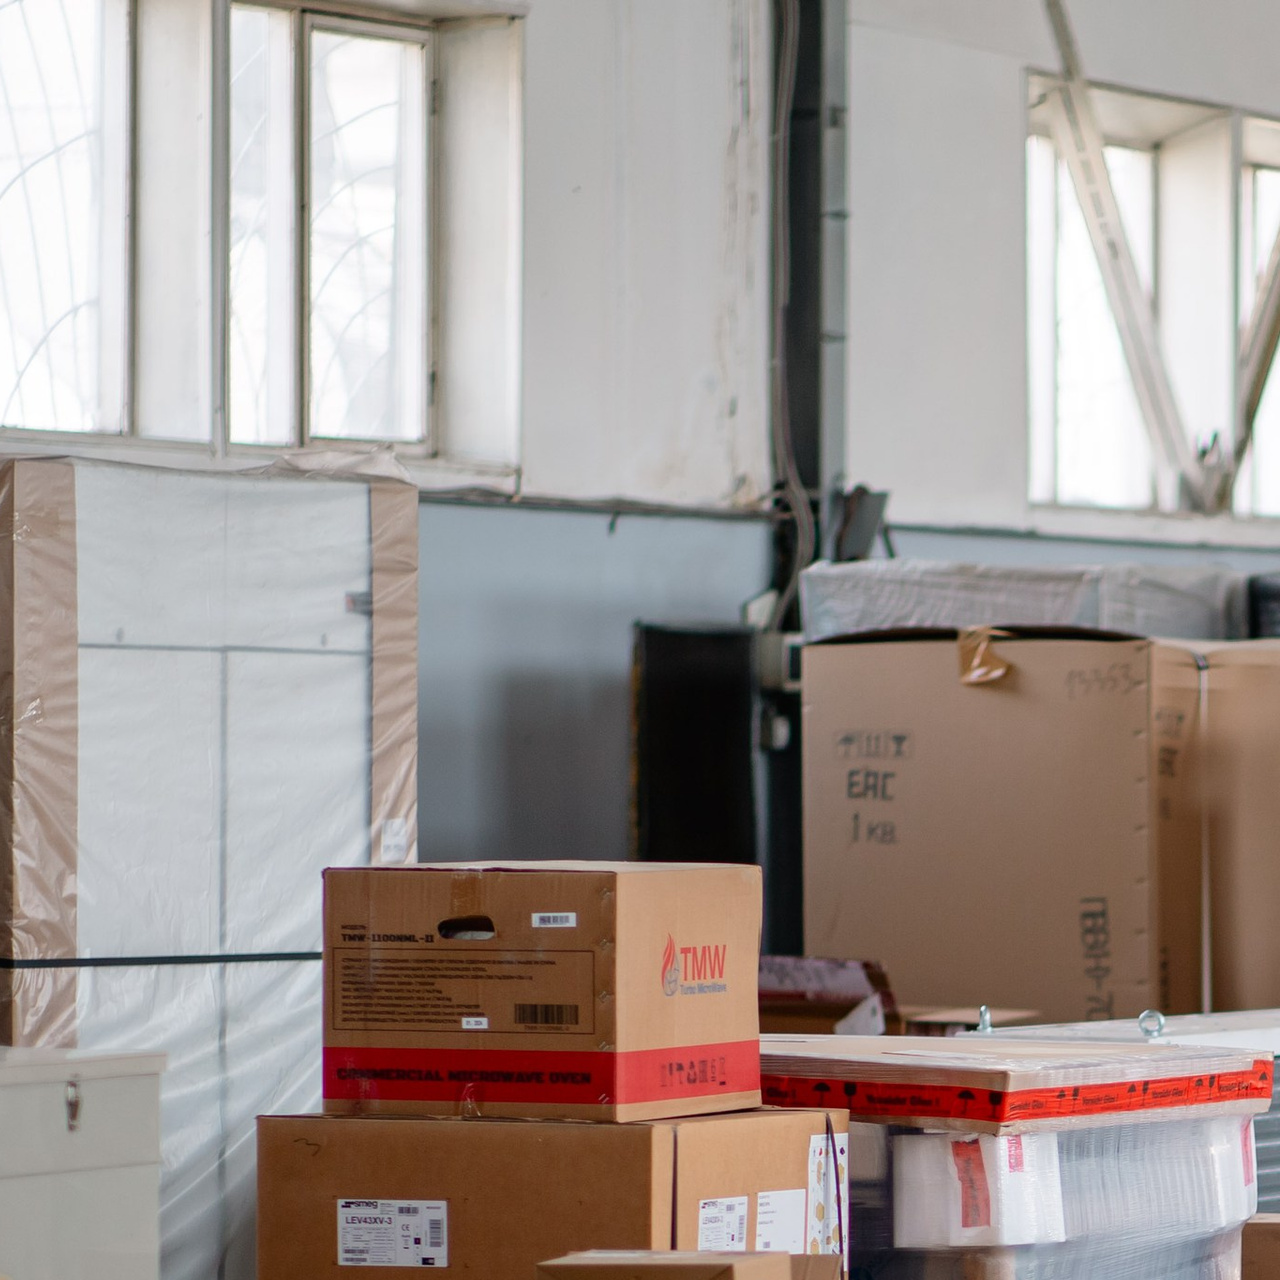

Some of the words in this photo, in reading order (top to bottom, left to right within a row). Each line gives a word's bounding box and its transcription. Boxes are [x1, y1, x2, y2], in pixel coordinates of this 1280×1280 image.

[680, 944, 727, 981] TMW
[337, 1068, 443, 1082] COMMERCIAL
[448, 1071, 543, 1085] MICROWAVE
[549, 1071, 591, 1085] OVEN
[354, 1201, 378, 1209] smeg
[345, 1216, 392, 1225] LEV43XV-3
